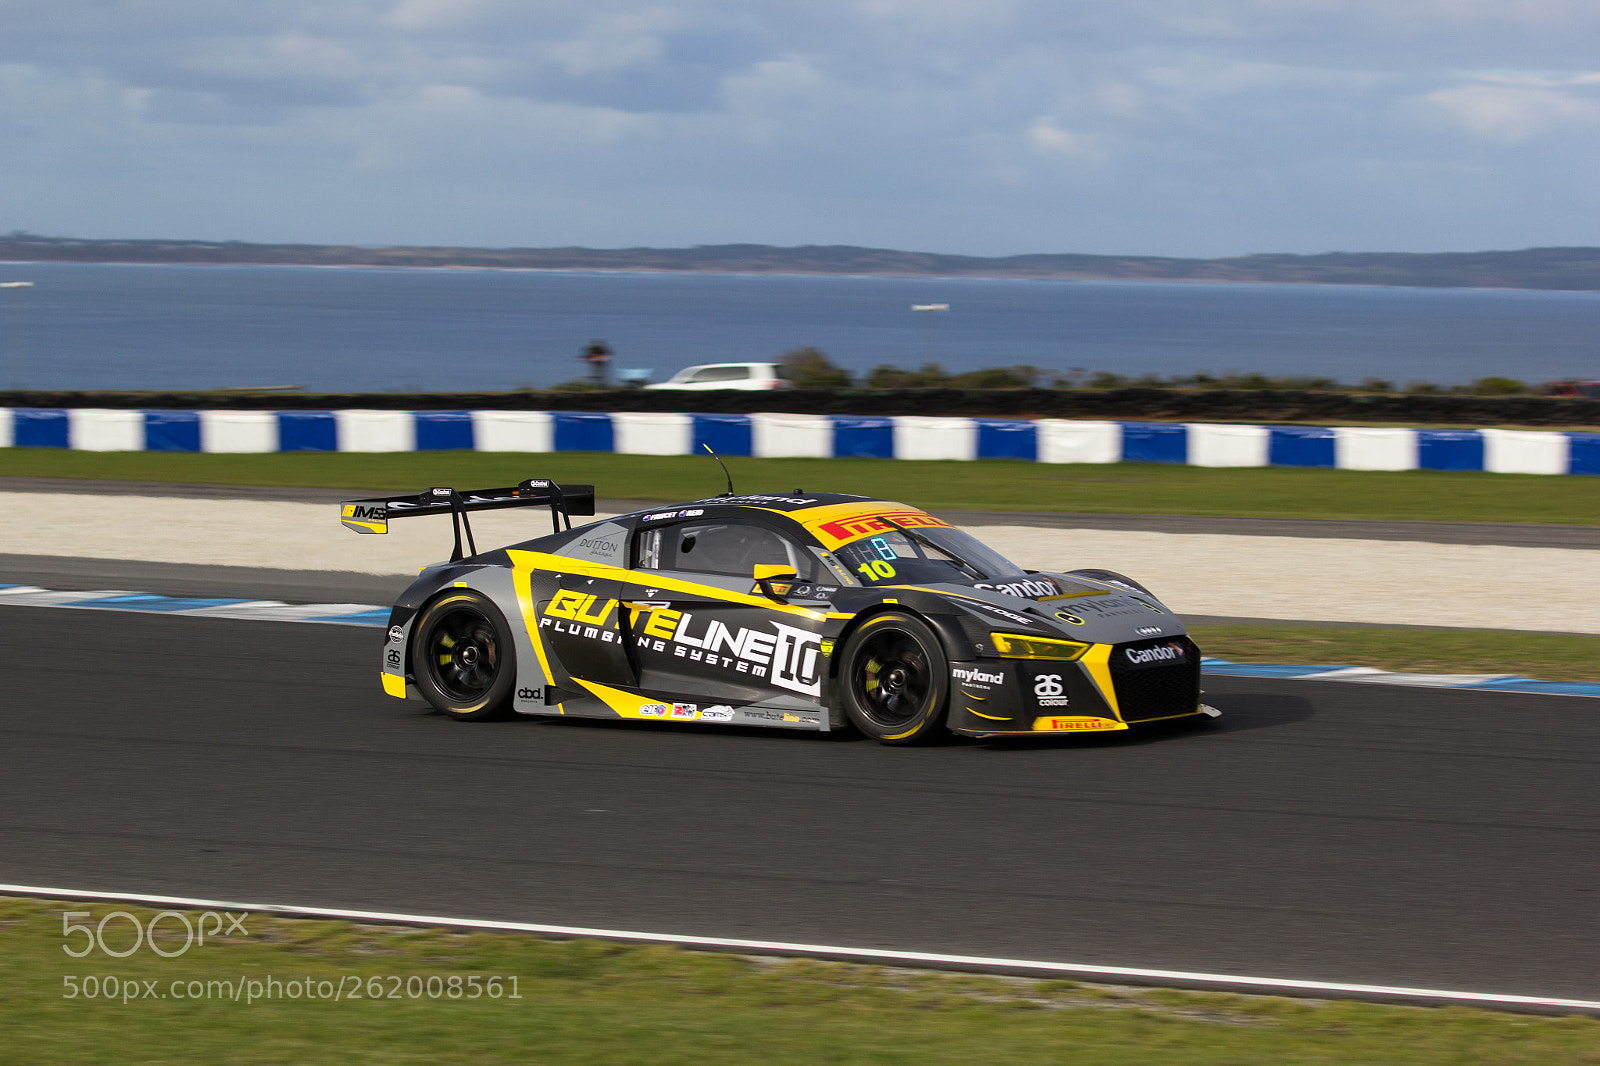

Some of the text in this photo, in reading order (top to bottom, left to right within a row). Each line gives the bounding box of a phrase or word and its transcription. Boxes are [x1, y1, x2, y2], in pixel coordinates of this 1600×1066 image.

[353, 506, 386, 521] IMS
[817, 512, 955, 541] PIRELL
[579, 538, 618, 553] DUTTON
[857, 559, 897, 582] 10
[543, 588, 777, 665] BUTELINE
[539, 617, 767, 678] PLUMBING SYSTEM
[1125, 644, 1177, 664] Candor
[952, 668, 1005, 685] myland
[1038, 698, 1069, 707] colour
[1051, 718, 1102, 730] PIRELLI
